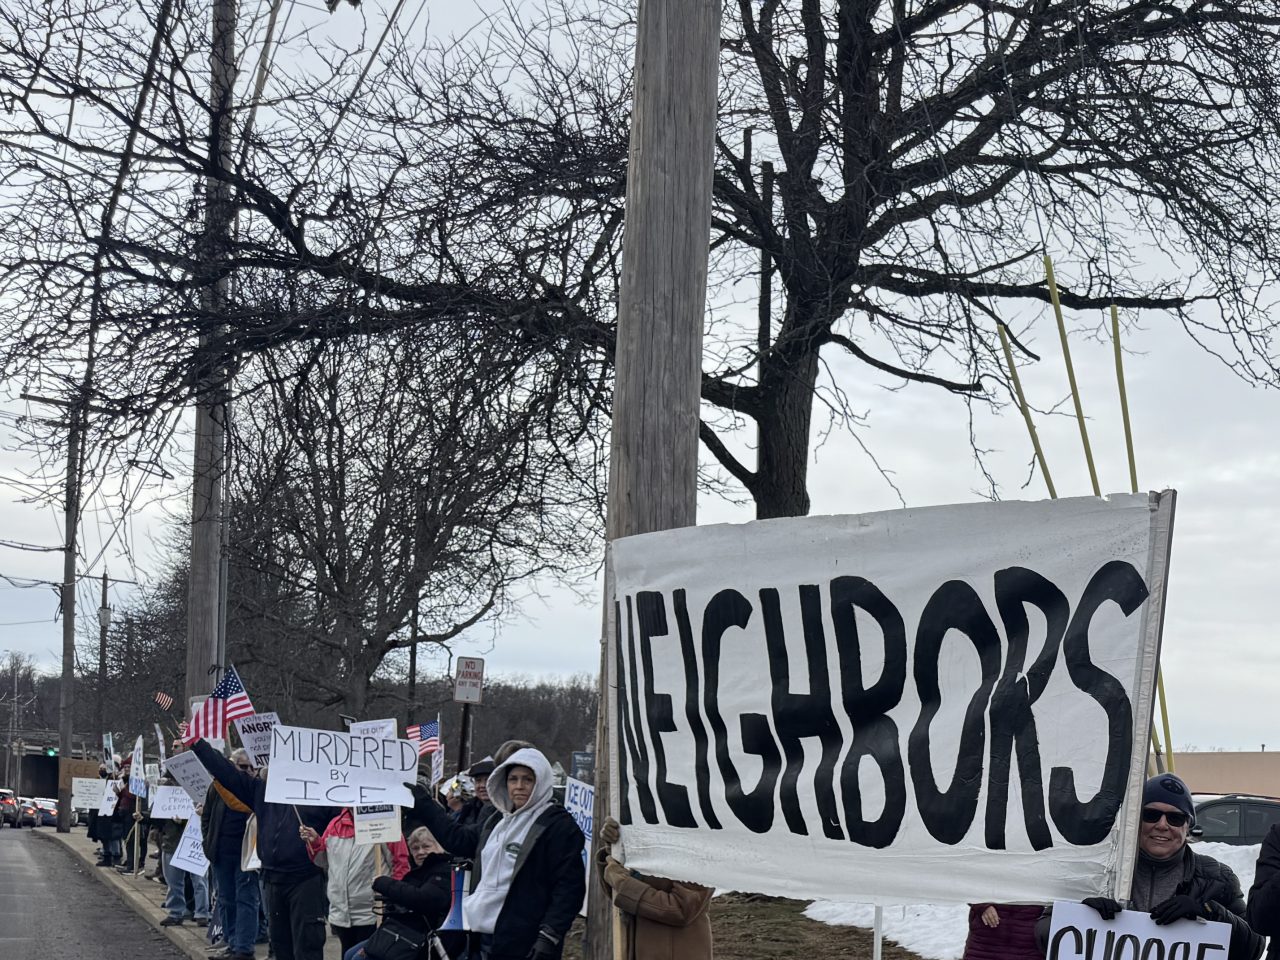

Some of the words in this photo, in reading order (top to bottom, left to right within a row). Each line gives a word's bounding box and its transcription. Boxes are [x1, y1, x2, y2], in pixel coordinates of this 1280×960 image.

[464, 661, 476, 670] NO
[457, 670, 481, 680] PARKING
[614, 560, 1150, 852] NEIGHBORS
[360, 727, 370, 735] ICE
[371, 726, 385, 734] OUT
[273, 728, 417, 772] MURDERED
[330, 769, 349, 783] BY
[285, 778, 386, 804] ICE
[568, 782, 579, 805] ICE
[580, 786, 594, 812] OUT
[188, 850, 204, 861] ICE
